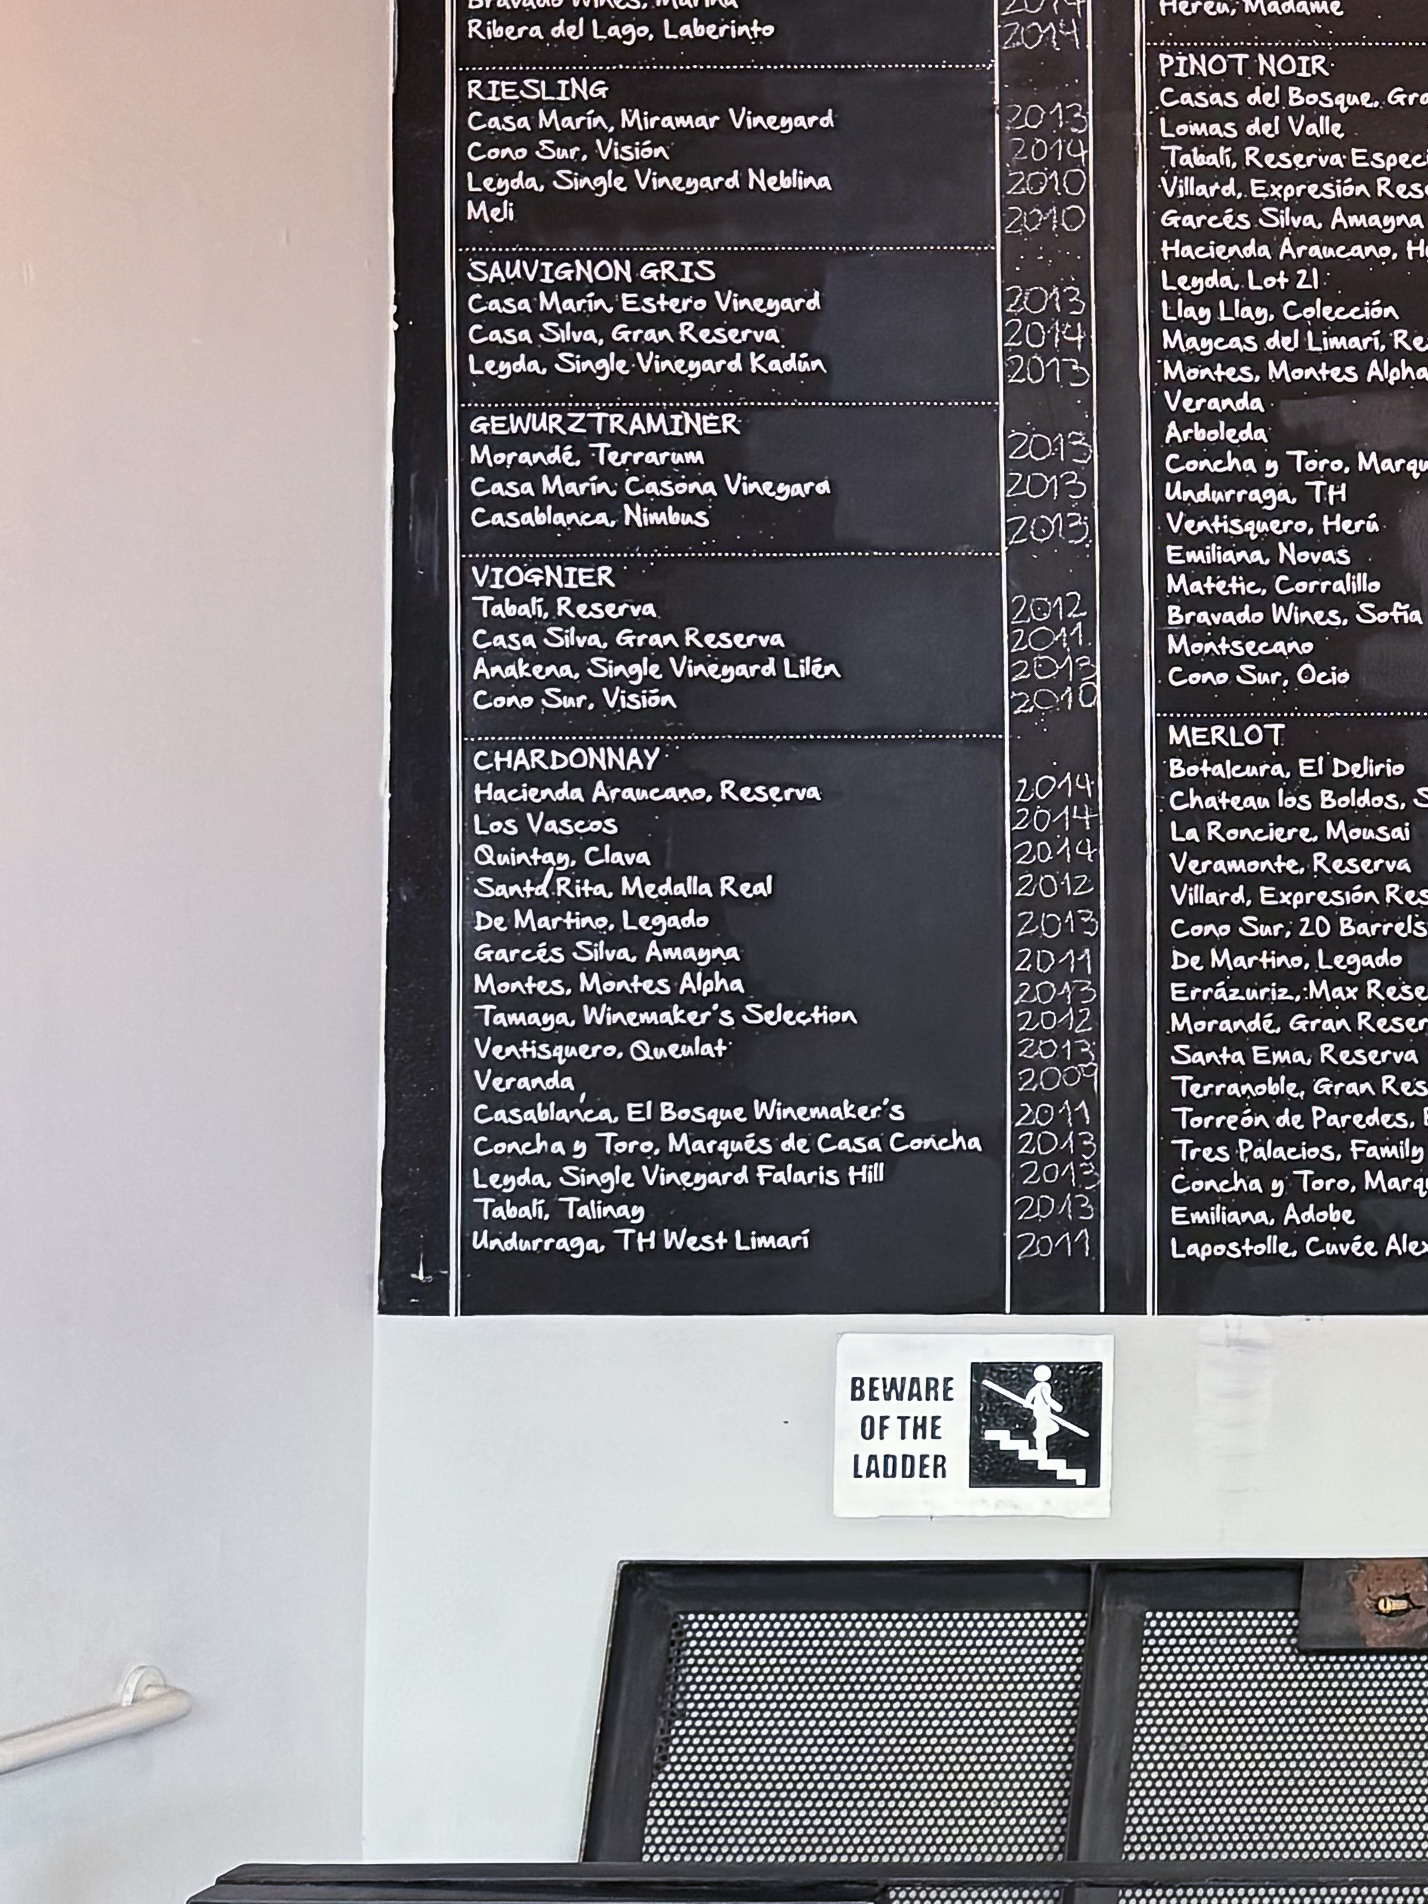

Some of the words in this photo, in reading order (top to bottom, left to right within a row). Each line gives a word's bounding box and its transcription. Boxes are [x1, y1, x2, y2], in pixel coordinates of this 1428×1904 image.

[1158, 52, 1250, 78] PINOT
[1257, 52, 1330, 78] NOIR
[467, 76, 610, 102] RIESLING
[1249, 177, 1372, 203] Expresión
[466, 258, 633, 284] SAUVIGNON
[639, 259, 716, 284] GRIS
[1005, 286, 1085, 315] 2013
[1161, 297, 1212, 326] Llay
[1216, 298, 1275, 326] Llay,
[1282, 297, 1400, 326] Colección
[1165, 510, 1314, 541] Ventisquero,
[471, 564, 616, 590] VIOGNIER
[1167, 631, 1314, 658] Montsecano
[1168, 723, 1286, 748] MERLOT
[472, 746, 661, 772] CHARDONNAY
[473, 780, 585, 804] Hacienda
[591, 779, 713, 804] Araucano,
[719, 779, 822, 803] Reserva
[1169, 787, 1271, 812] Chateau
[1277, 787, 1313, 811] los
[1319, 787, 1406, 811] Boldos,
[1170, 918, 1231, 941] Cono
[1339, 913, 1428, 938] Barrels
[473, 1004, 576, 1032] Tamaya,
[741, 1002, 858, 1027] Selection
[1170, 1234, 1298, 1262] Lapostolle,
[1305, 1234, 1379, 1257] Cuvée
[850, 1377, 955, 1402] BEWARE
[860, 1415, 890, 1440] OF
[897, 1415, 942, 1440] THE
[852, 1454, 947, 1479] LADDER
